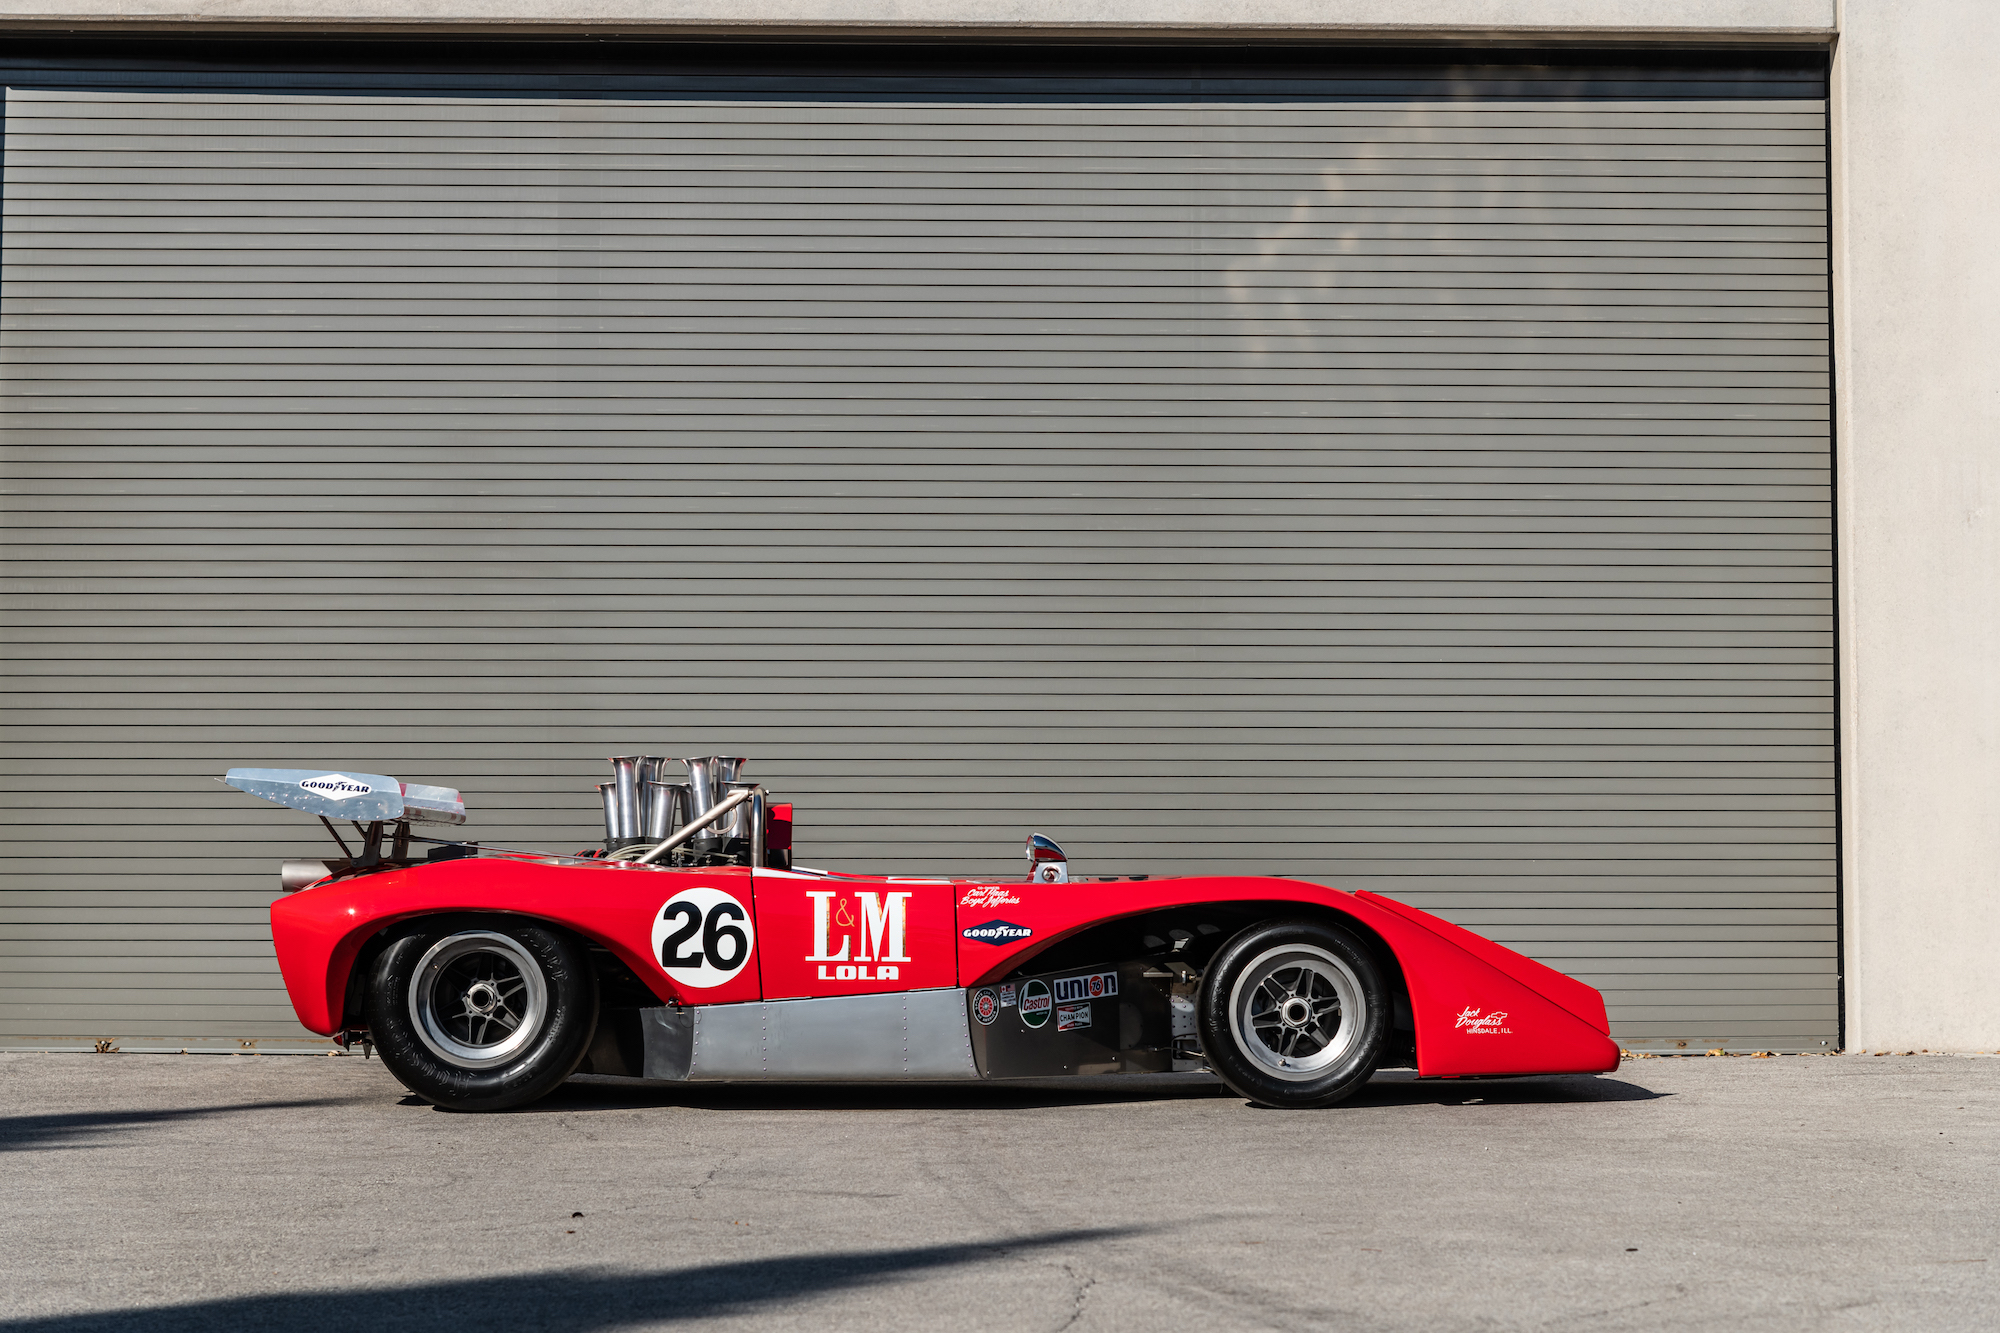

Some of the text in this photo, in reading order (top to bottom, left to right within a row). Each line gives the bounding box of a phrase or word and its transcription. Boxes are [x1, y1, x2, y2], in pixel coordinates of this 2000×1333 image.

[301, 780, 370, 793] GOODYEAR
[967, 888, 1009, 897] Carl Haas
[960, 896, 987, 907] Boyd
[805, 891, 912, 962] L&M
[963, 925, 1032, 939] GOODYEAR
[662, 900, 748, 971] 26
[817, 965, 899, 980] LOLA
[1091, 980, 1101, 992] 76
[1024, 996, 1050, 1011] Castrol
[1059, 1011, 1089, 1022] CHAMPION
[1456, 1006, 1480, 1017] Jack
[1455, 1015, 1502, 1029] Douglass
